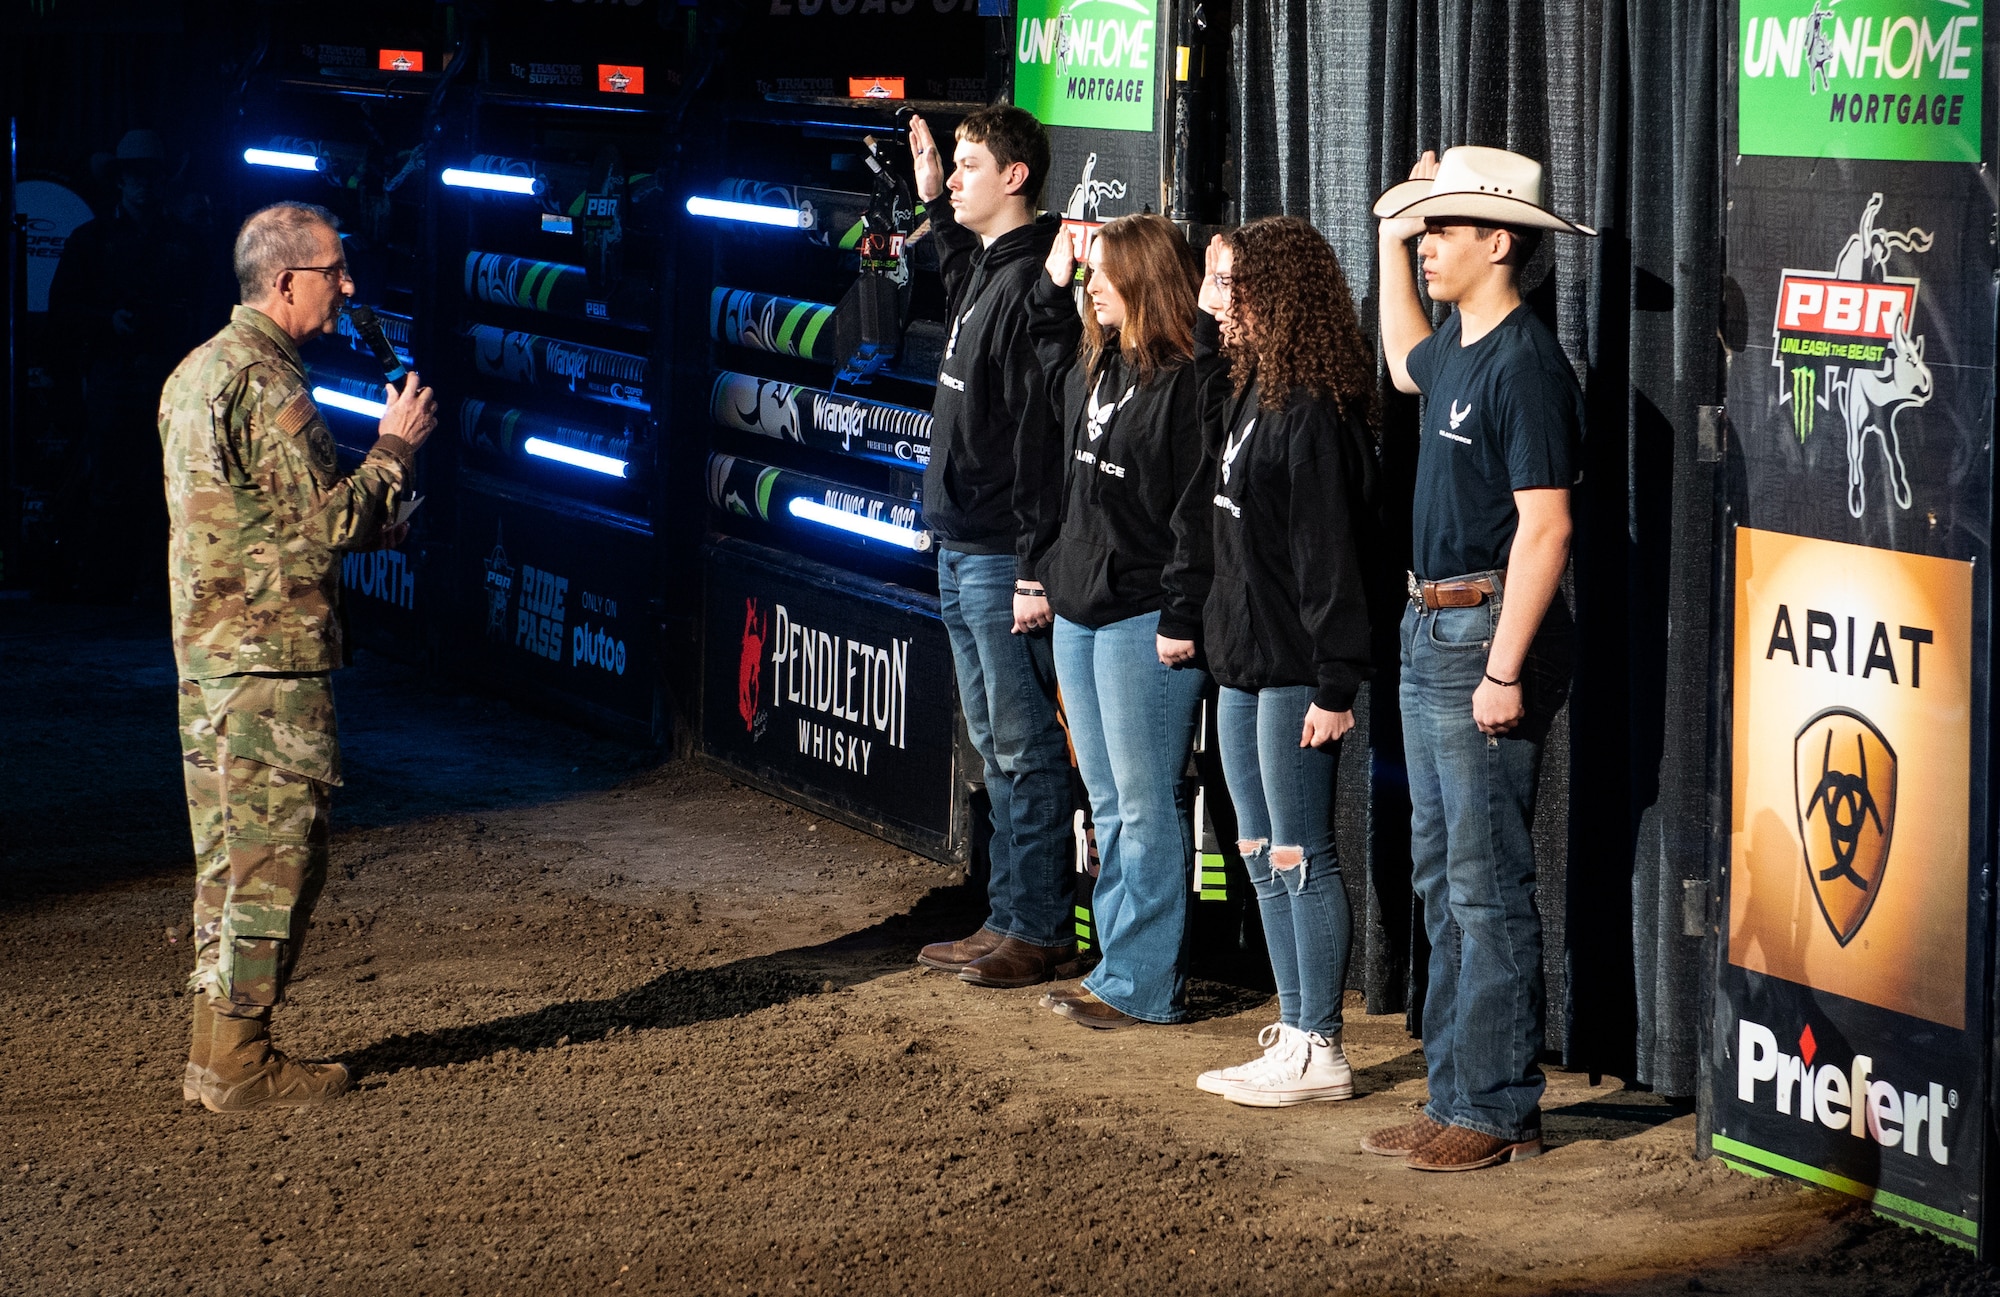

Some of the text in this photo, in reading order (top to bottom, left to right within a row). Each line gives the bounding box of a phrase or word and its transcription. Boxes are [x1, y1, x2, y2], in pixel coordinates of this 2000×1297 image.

[528, 61, 583, 76] TRACTOR
[1018, 16, 1153, 69] UNINHOME
[1743, 15, 1978, 80] UNINHOME
[528, 72, 568, 85] SUPPLY
[1066, 76, 1144, 103] MORTGAGE
[1829, 93, 1964, 125] MORTGAGE
[586, 198, 617, 217] PBR
[586, 302, 607, 317] PBR
[1783, 281, 1907, 334] PBR
[546, 341, 589, 392] Wrangler
[1780, 336, 1885, 362] UNLEASH THE BEAST
[812, 393, 868, 451] Wrangler
[486, 570, 512, 589] PBR
[520, 564, 569, 622] RIDE
[581, 591, 617, 618] ONLY ON
[515, 607, 564, 661] PASS
[1766, 603, 1934, 689] ARIAT
[772, 603, 909, 750] PENDLETON
[798, 718, 872, 776] WHISKY
[1737, 1018, 1949, 1166] Priefert
